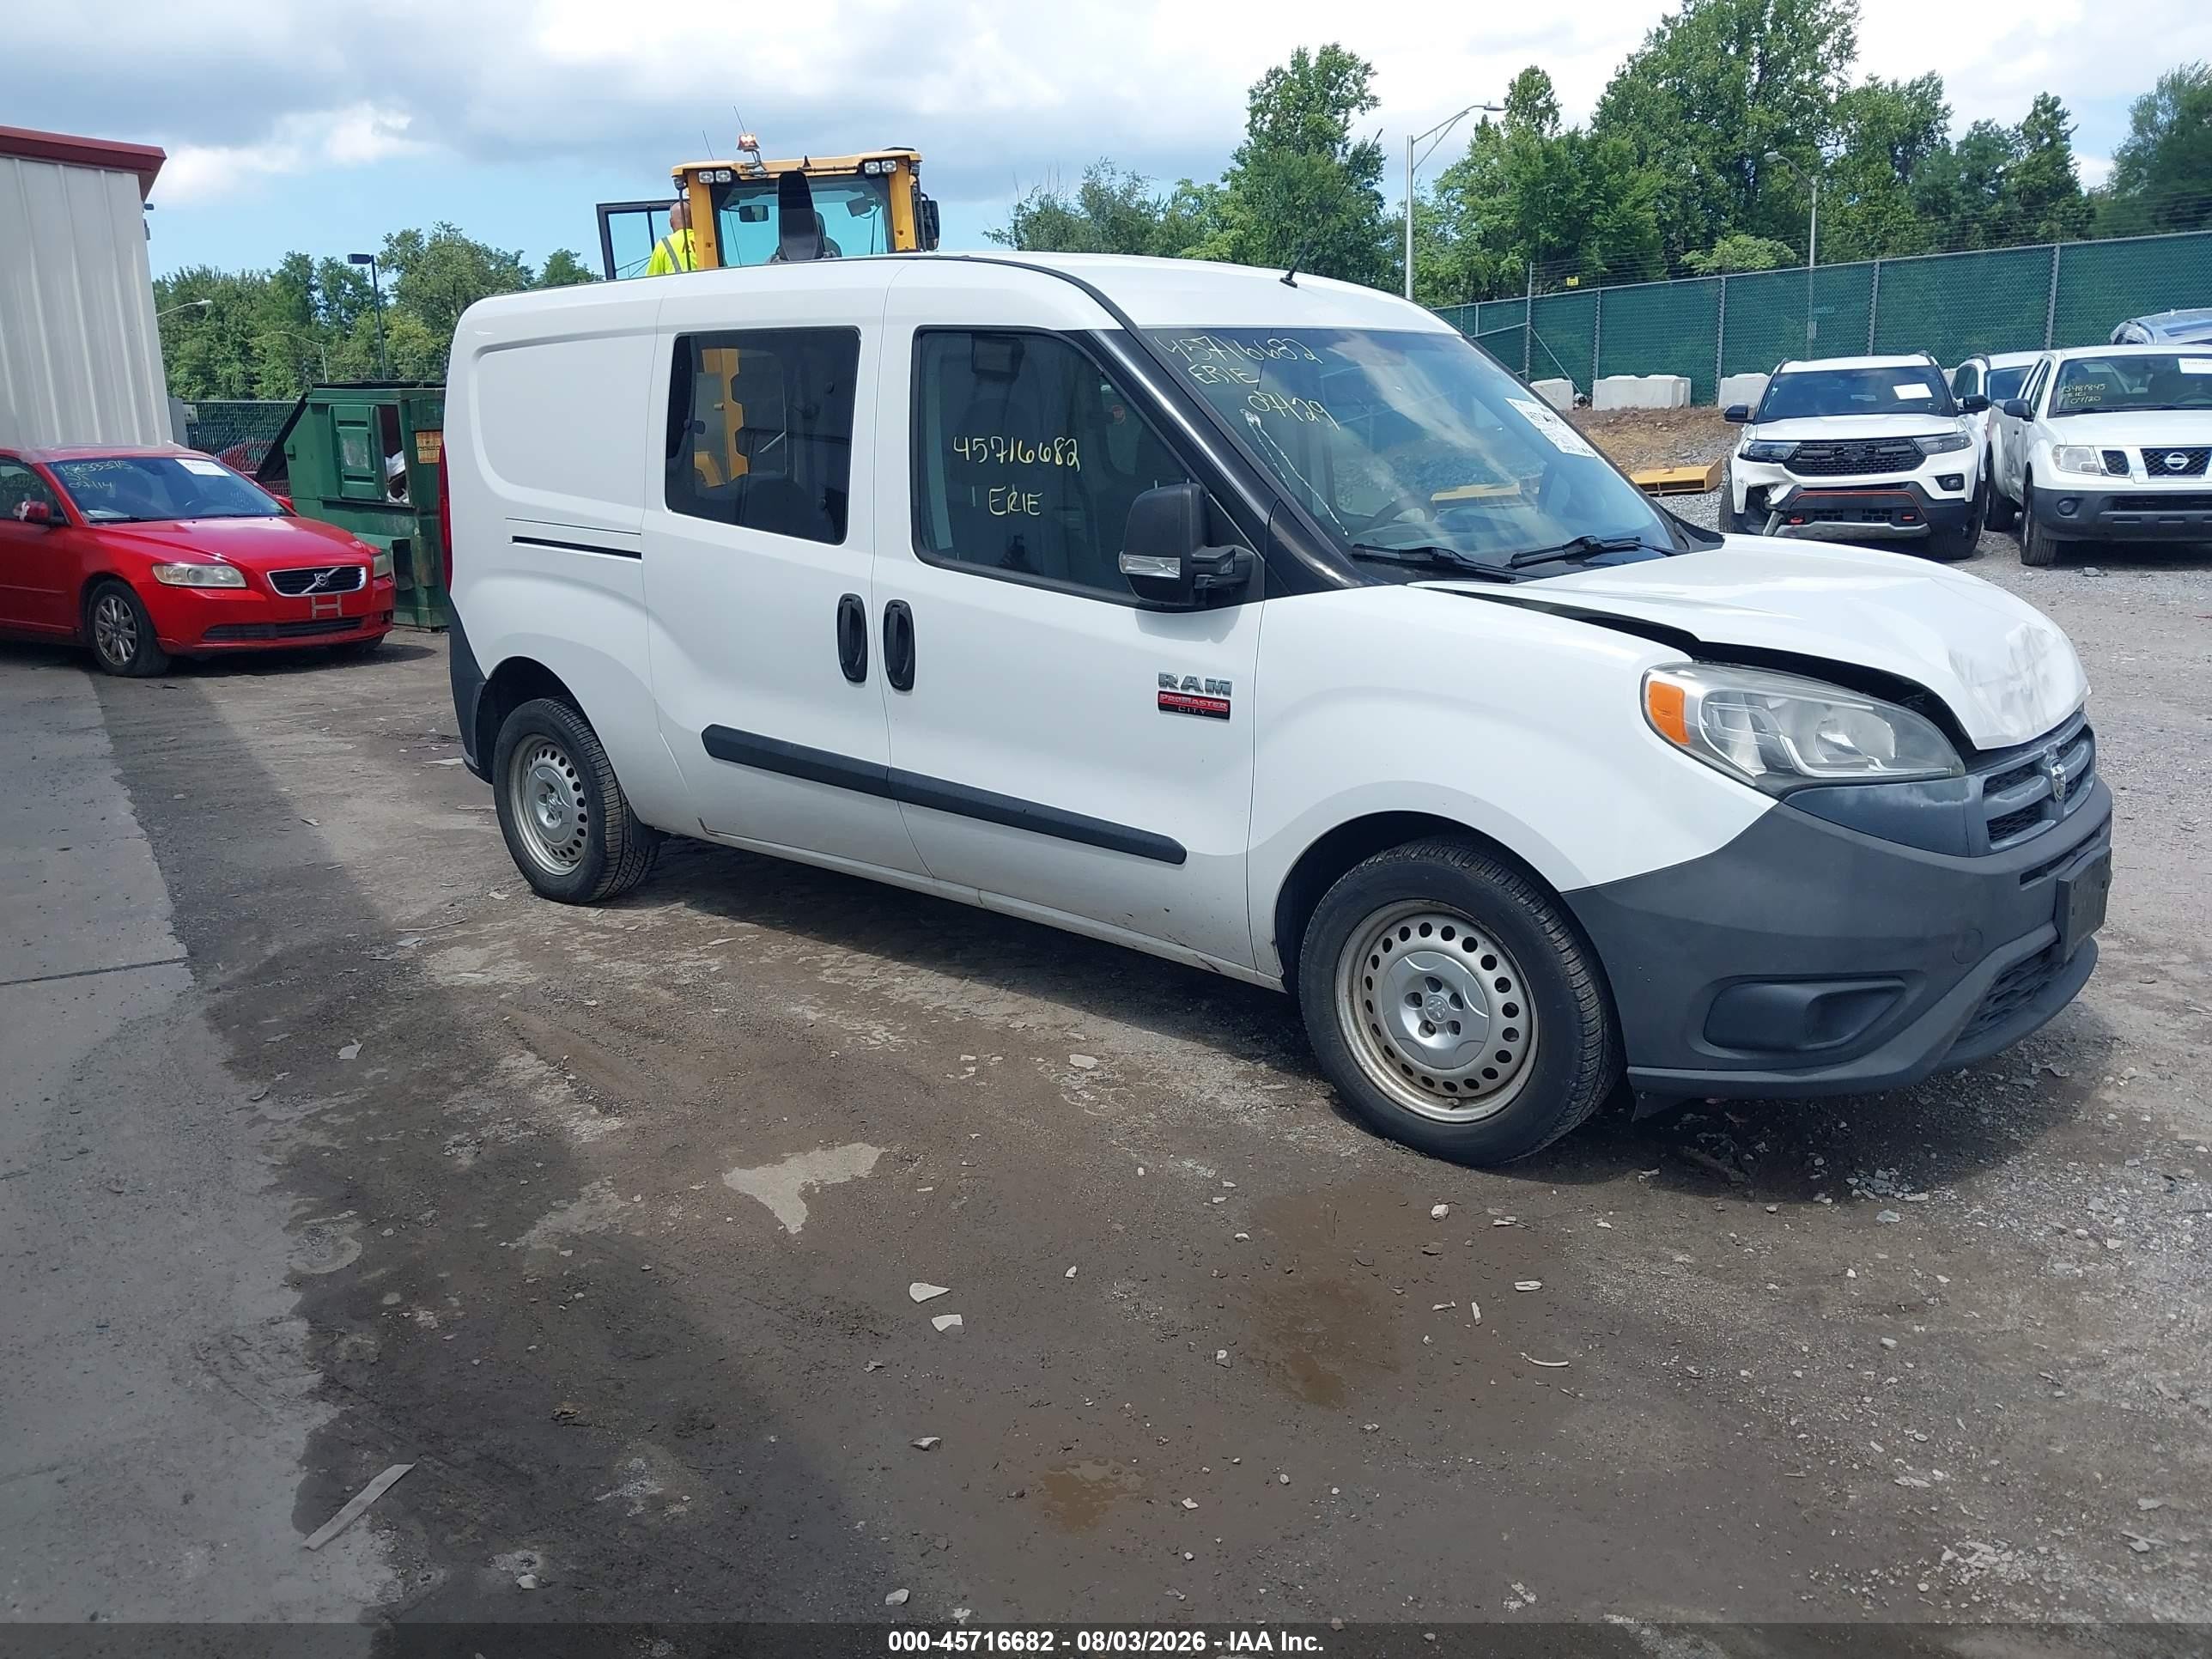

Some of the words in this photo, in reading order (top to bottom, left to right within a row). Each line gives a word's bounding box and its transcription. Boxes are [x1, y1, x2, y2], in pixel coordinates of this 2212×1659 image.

[1154, 336, 1323, 364] 45716682
[1188, 364, 1260, 384] ERIE
[1248, 390, 1340, 431] 07/29
[953, 435, 1081, 472] 45716682
[988, 485, 1043, 516] ERIE
[1158, 672, 1232, 697] RAM
[1178, 706, 1206, 714] CITY
